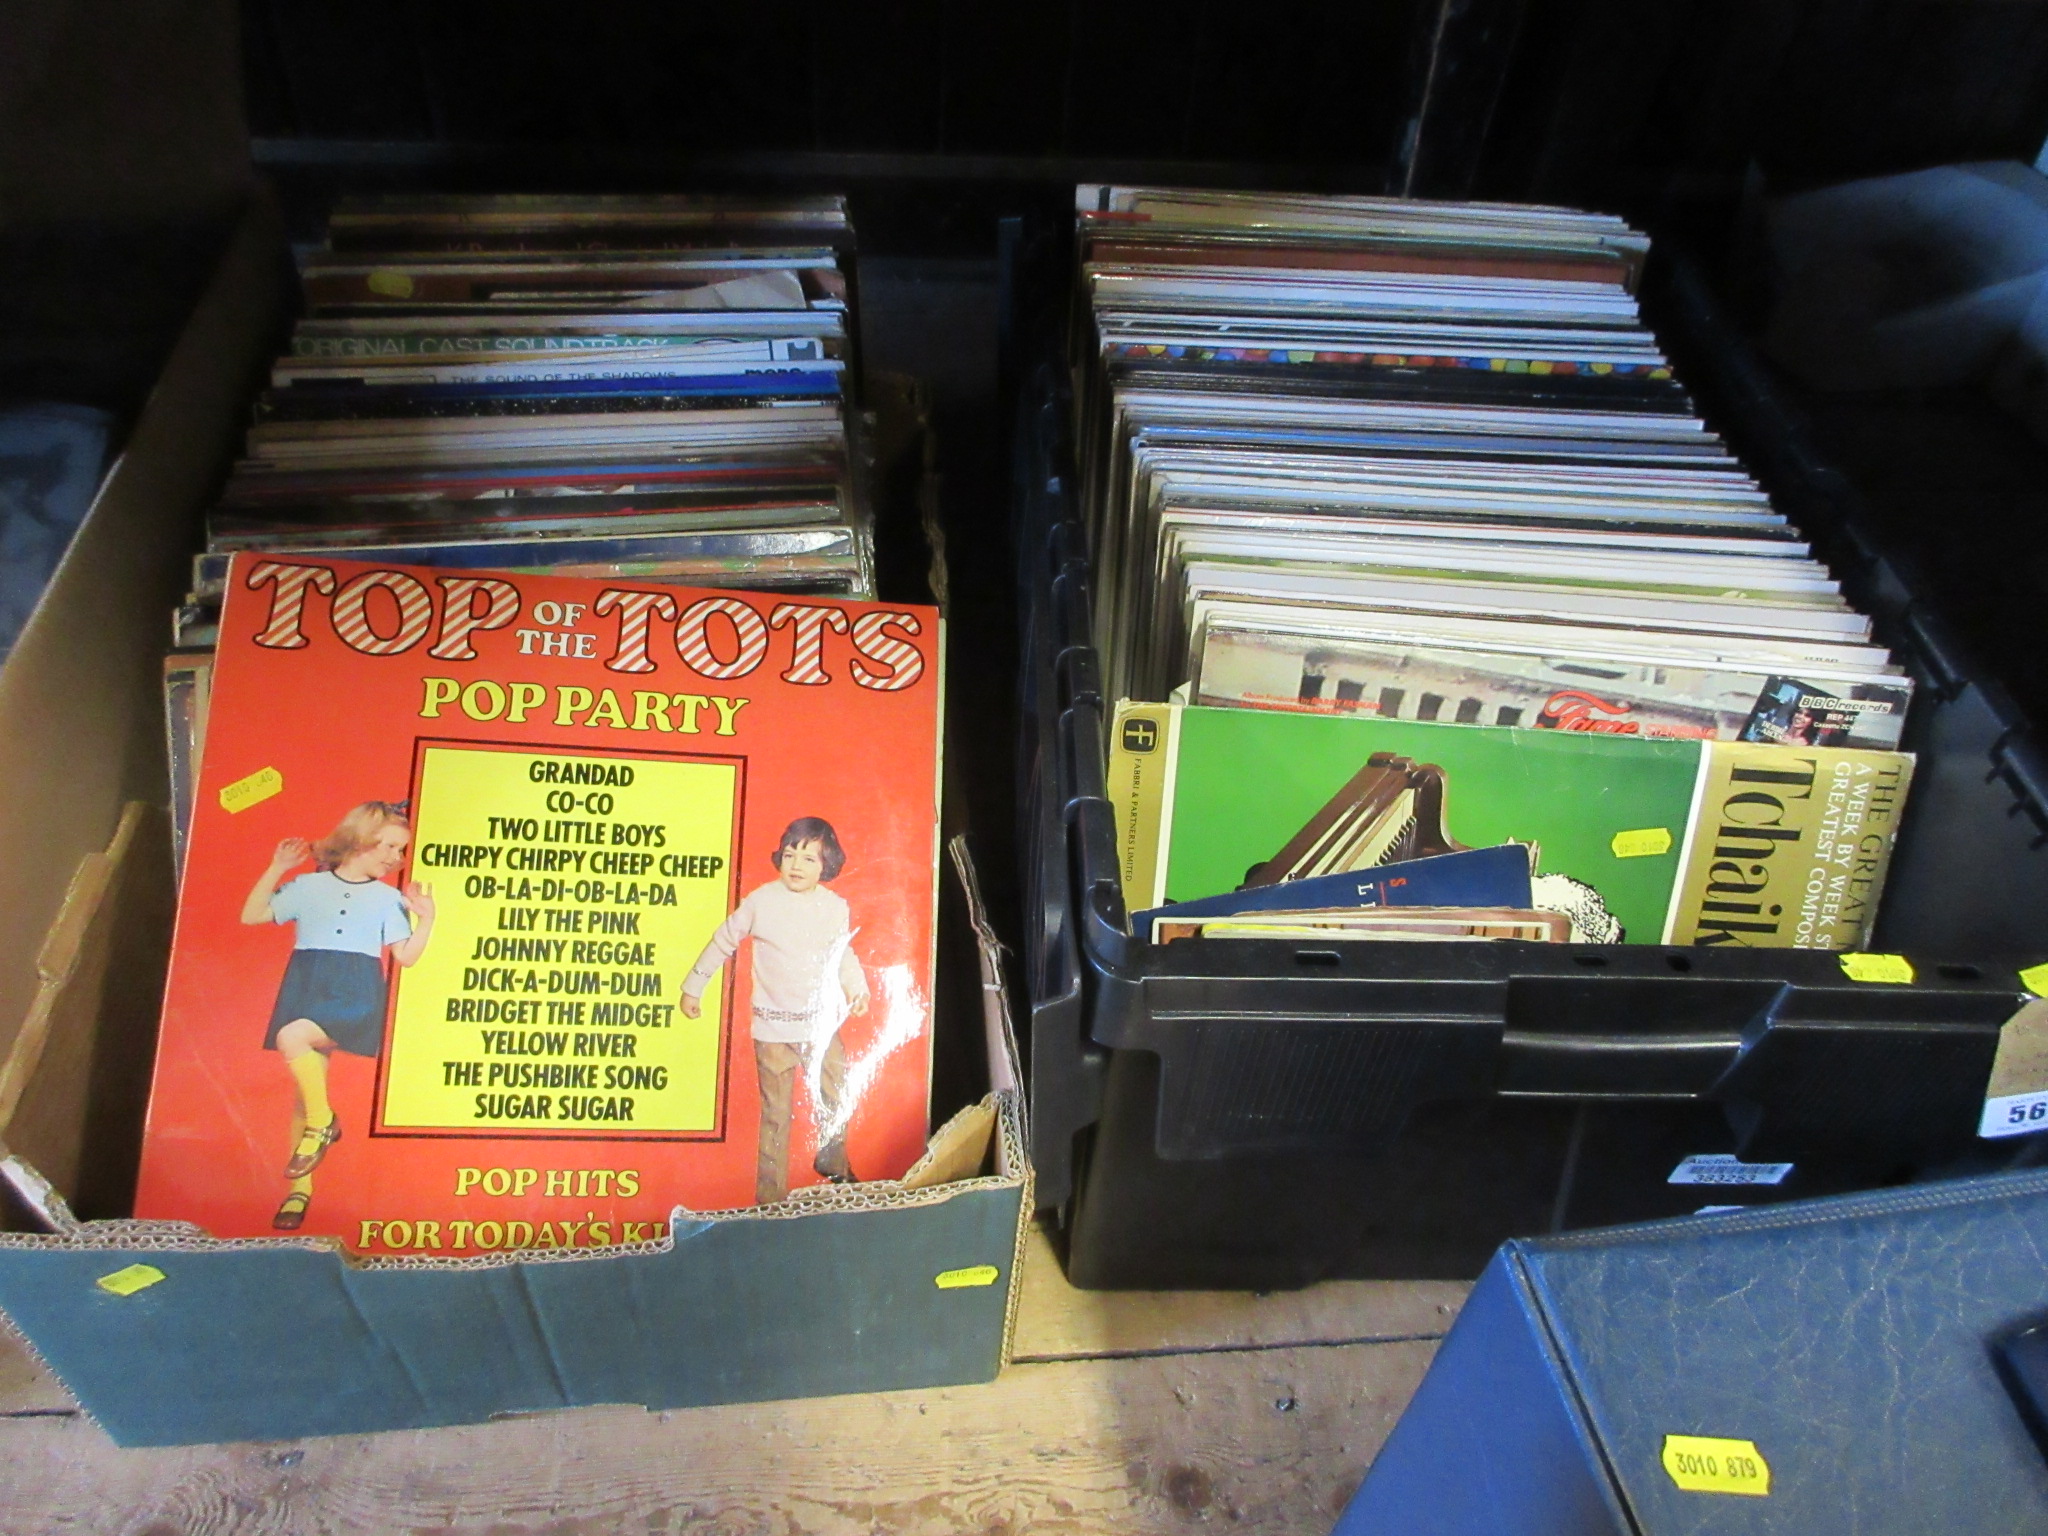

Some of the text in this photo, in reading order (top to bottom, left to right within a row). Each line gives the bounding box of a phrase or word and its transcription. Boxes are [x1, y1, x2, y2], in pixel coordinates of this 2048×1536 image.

[420, 338, 489, 353] CAST
[246, 560, 925, 692] TOP OF THE TOTS
[418, 677, 750, 736] POP PARTY
[1533, 690, 1640, 735] Fame
[1800, 695, 1892, 713] BBC records
[529, 761, 634, 786] GRANDAD
[1133, 758, 1142, 789] FABBRI
[1854, 762, 1873, 776] A
[546, 791, 613, 815] CO-CO
[1841, 782, 1870, 836] WEEK
[1867, 764, 1902, 823] THE
[1128, 801, 1139, 845] PARTNERS
[1814, 761, 1852, 862] GREATEST
[488, 817, 666, 847] TWO LITTLE BOYS
[421, 844, 723, 878] CHIRPY CHIRPY CHEEP CHEEP
[1125, 846, 1135, 882] LIMITED
[1693, 758, 1818, 947] Tchaik
[1834, 844, 1855, 869] BY
[464, 875, 677, 906] OB-LA-DI-OB-LA-DA
[1842, 833, 1884, 930] GREAT
[1819, 875, 1847, 927] WEEK
[498, 907, 641, 935] LILY THE PINK
[471, 937, 656, 966] JOHNNY REGGAE
[463, 967, 662, 997] DICK-A-DUM-DUM
[446, 998, 675, 1028] BRIDGET THE MIDGET
[481, 1030, 637, 1058] YELLOW RIVER
[443, 1061, 668, 1090] THE PUSHBIKE SONG
[474, 1093, 634, 1121] SUGAR SUGAR
[454, 1167, 640, 1198] POP HITS
[358, 1212, 665, 1250] FOR TODAY'S KI
[1675, 1453, 1757, 1479] 3010 879
